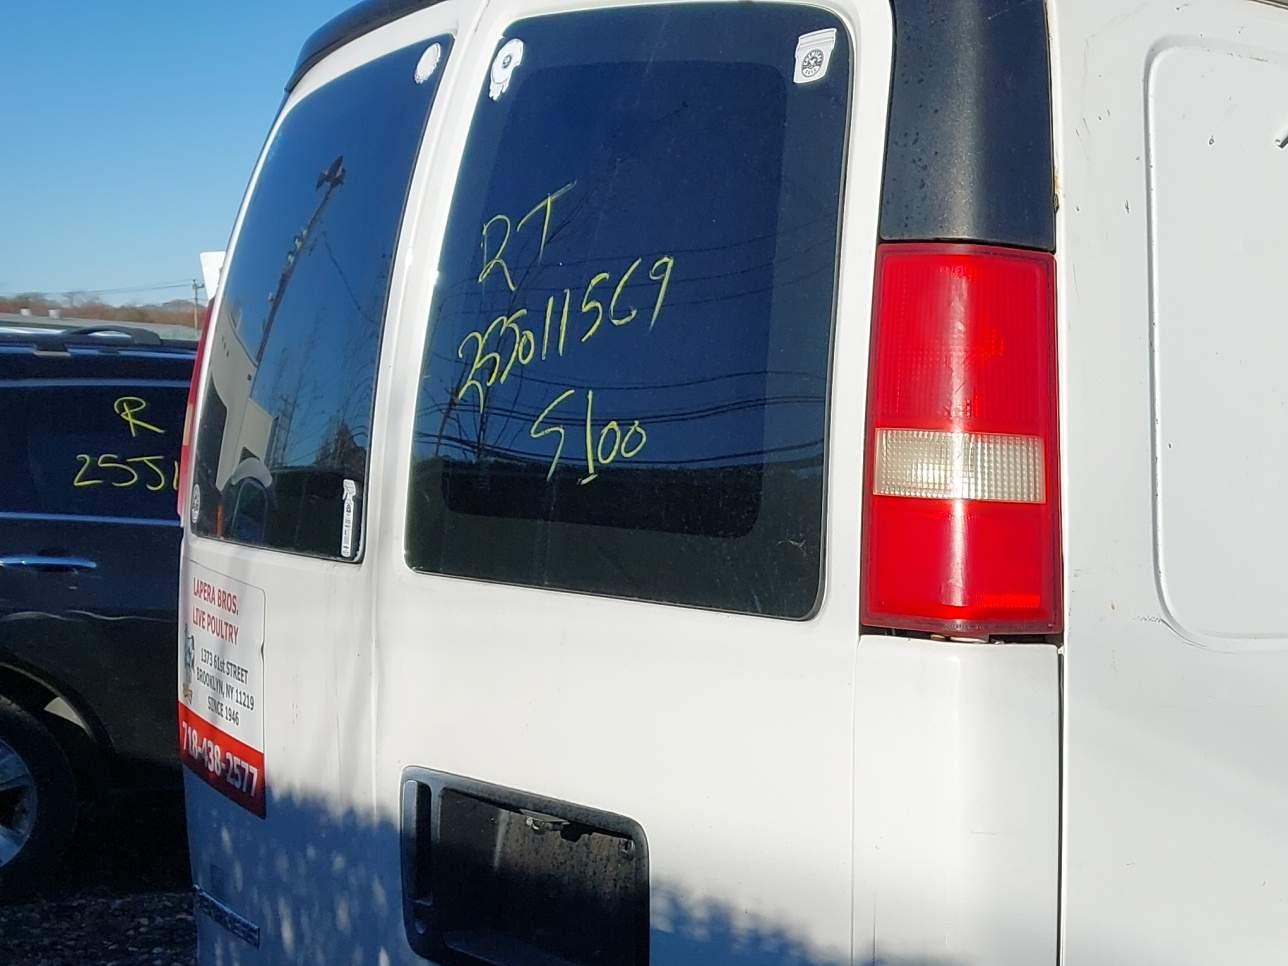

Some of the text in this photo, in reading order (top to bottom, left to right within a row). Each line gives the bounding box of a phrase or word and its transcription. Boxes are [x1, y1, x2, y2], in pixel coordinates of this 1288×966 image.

[114, 396, 165, 437] R
[217, 588, 239, 616] BROS.
[206, 613, 239, 645] POULTRY
[201, 648, 213, 667] 1373
[226, 661, 249, 685] STREET
[208, 695, 240, 727] SINCE 1946
[225, 682, 235, 701] NY
[235, 688, 255, 711] 11219
[182, 720, 258, 797] 718-438-2577
